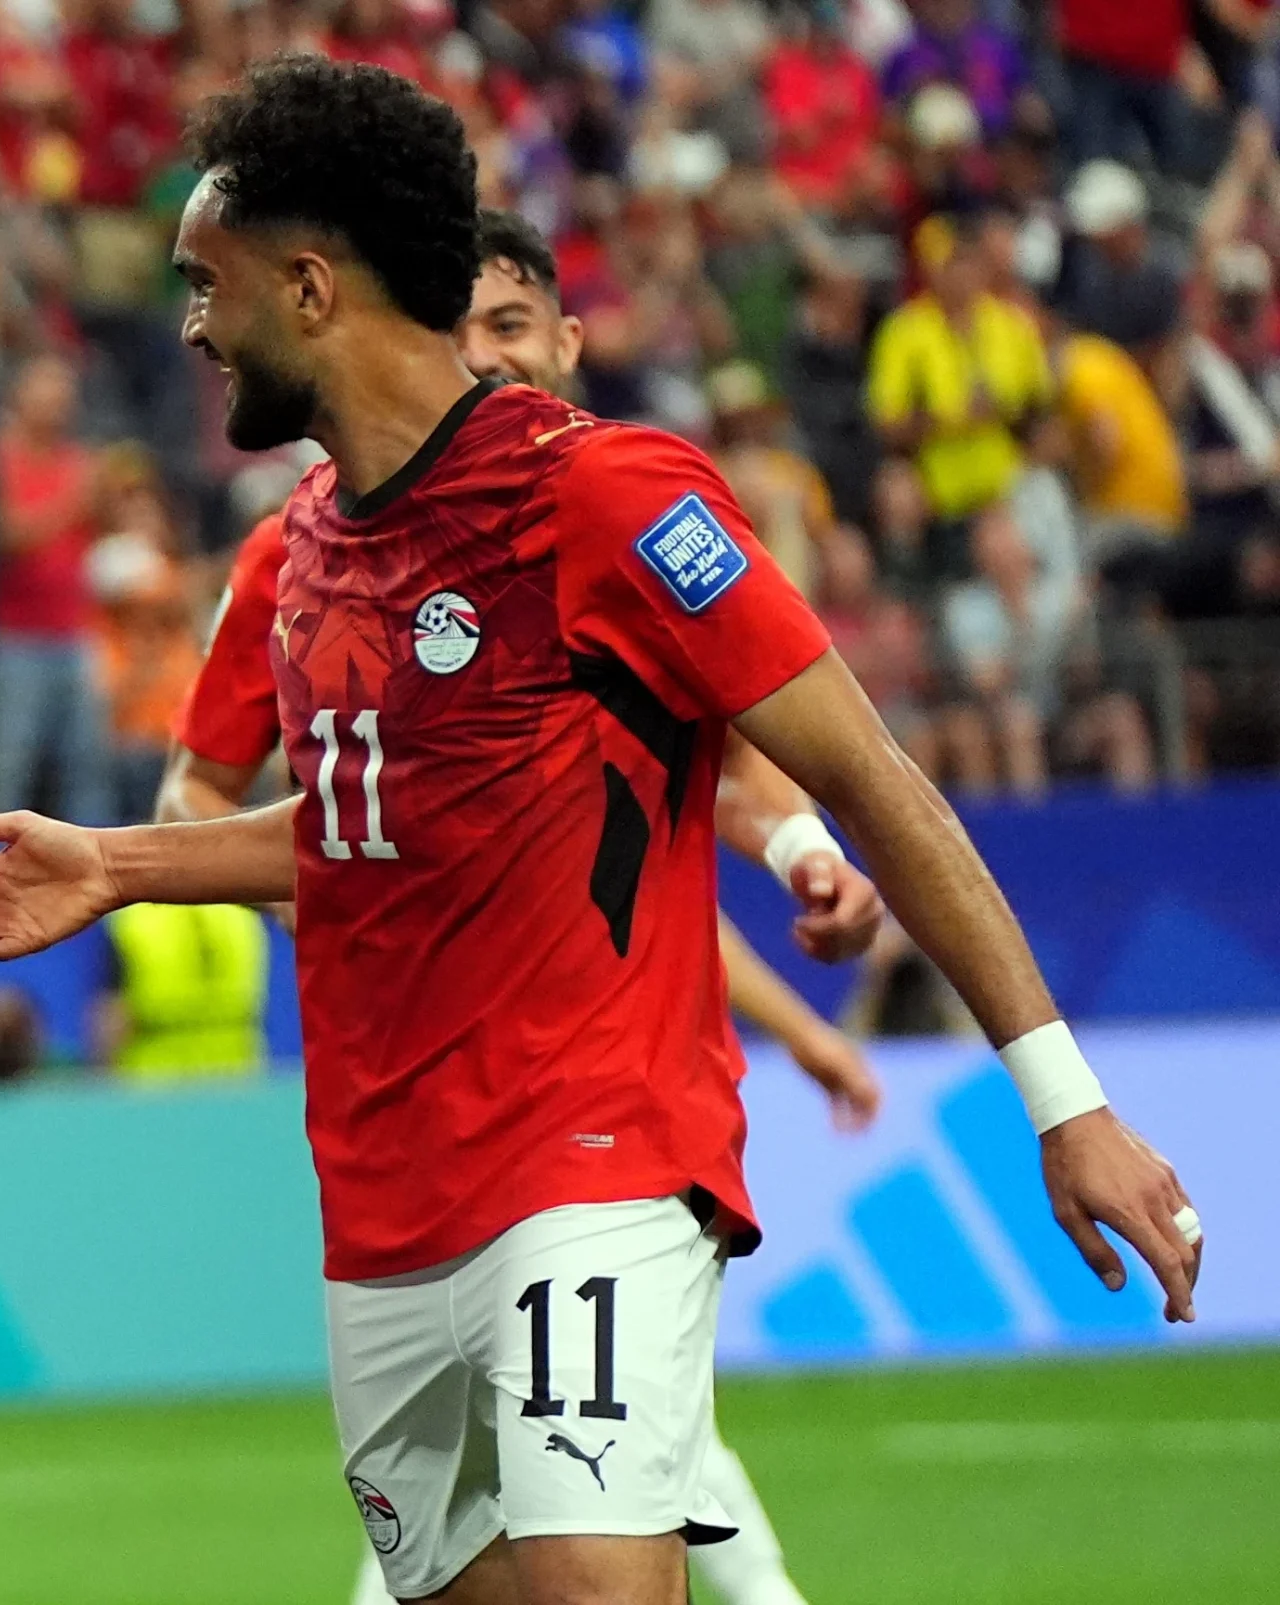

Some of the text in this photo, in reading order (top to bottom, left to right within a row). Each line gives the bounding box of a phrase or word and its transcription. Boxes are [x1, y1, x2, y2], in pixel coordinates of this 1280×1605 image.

[652, 512, 702, 556] FOOTBALL
[663, 522, 714, 572] UNITES
[676, 536, 729, 589] the World
[309, 709, 400, 859] 11
[515, 1276, 627, 1421] 11
